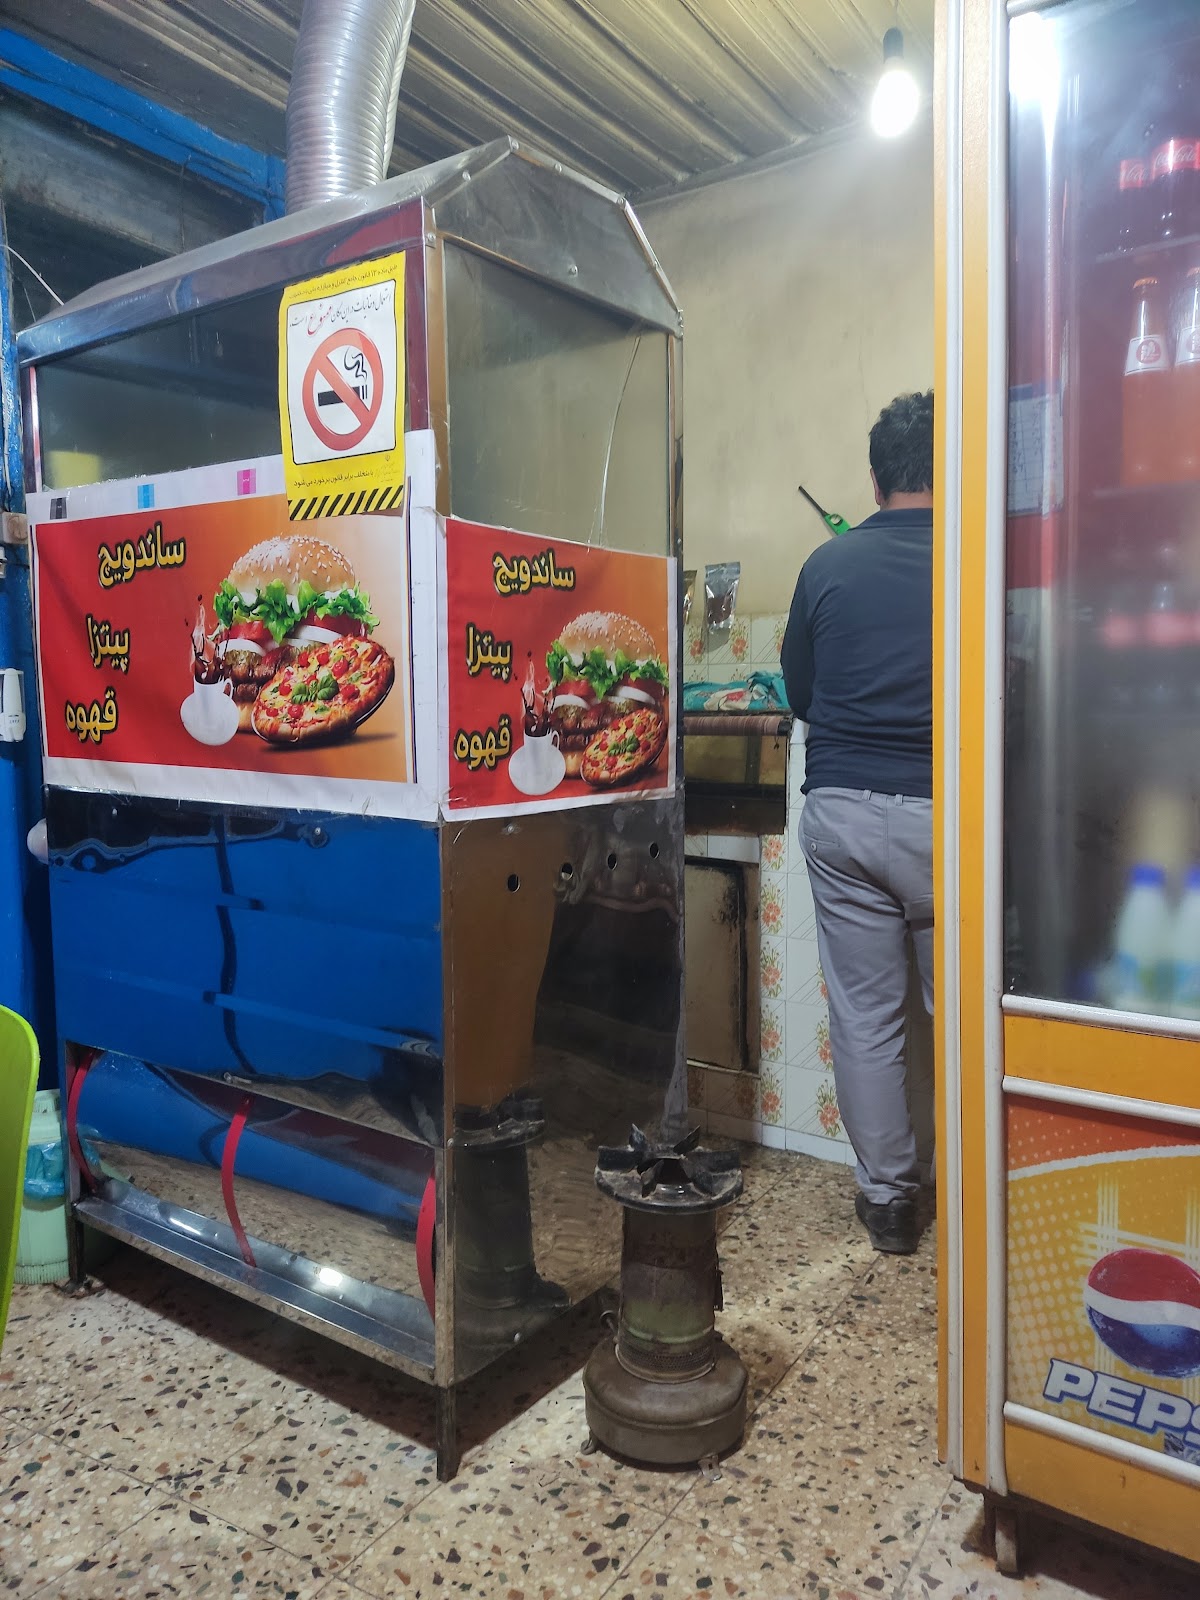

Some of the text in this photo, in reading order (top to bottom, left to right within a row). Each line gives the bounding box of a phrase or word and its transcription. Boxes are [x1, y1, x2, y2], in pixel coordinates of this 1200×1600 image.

[357, 272, 370, 281] قانون
[375, 288, 392, 310] استعمال
[307, 304, 332, 335] ممنوع
[354, 294, 375, 319] دخانیات
[330, 474, 342, 483] قانون
[98, 521, 186, 588] ساندویچ
[493, 548, 576, 597] ساندویچ
[86, 614, 130, 674] پیتزا
[466, 622, 512, 683] پیتزا
[65, 687, 119, 744] قهوه
[455, 714, 512, 771] قهوه
[1043, 1358, 1200, 1448] PEP
